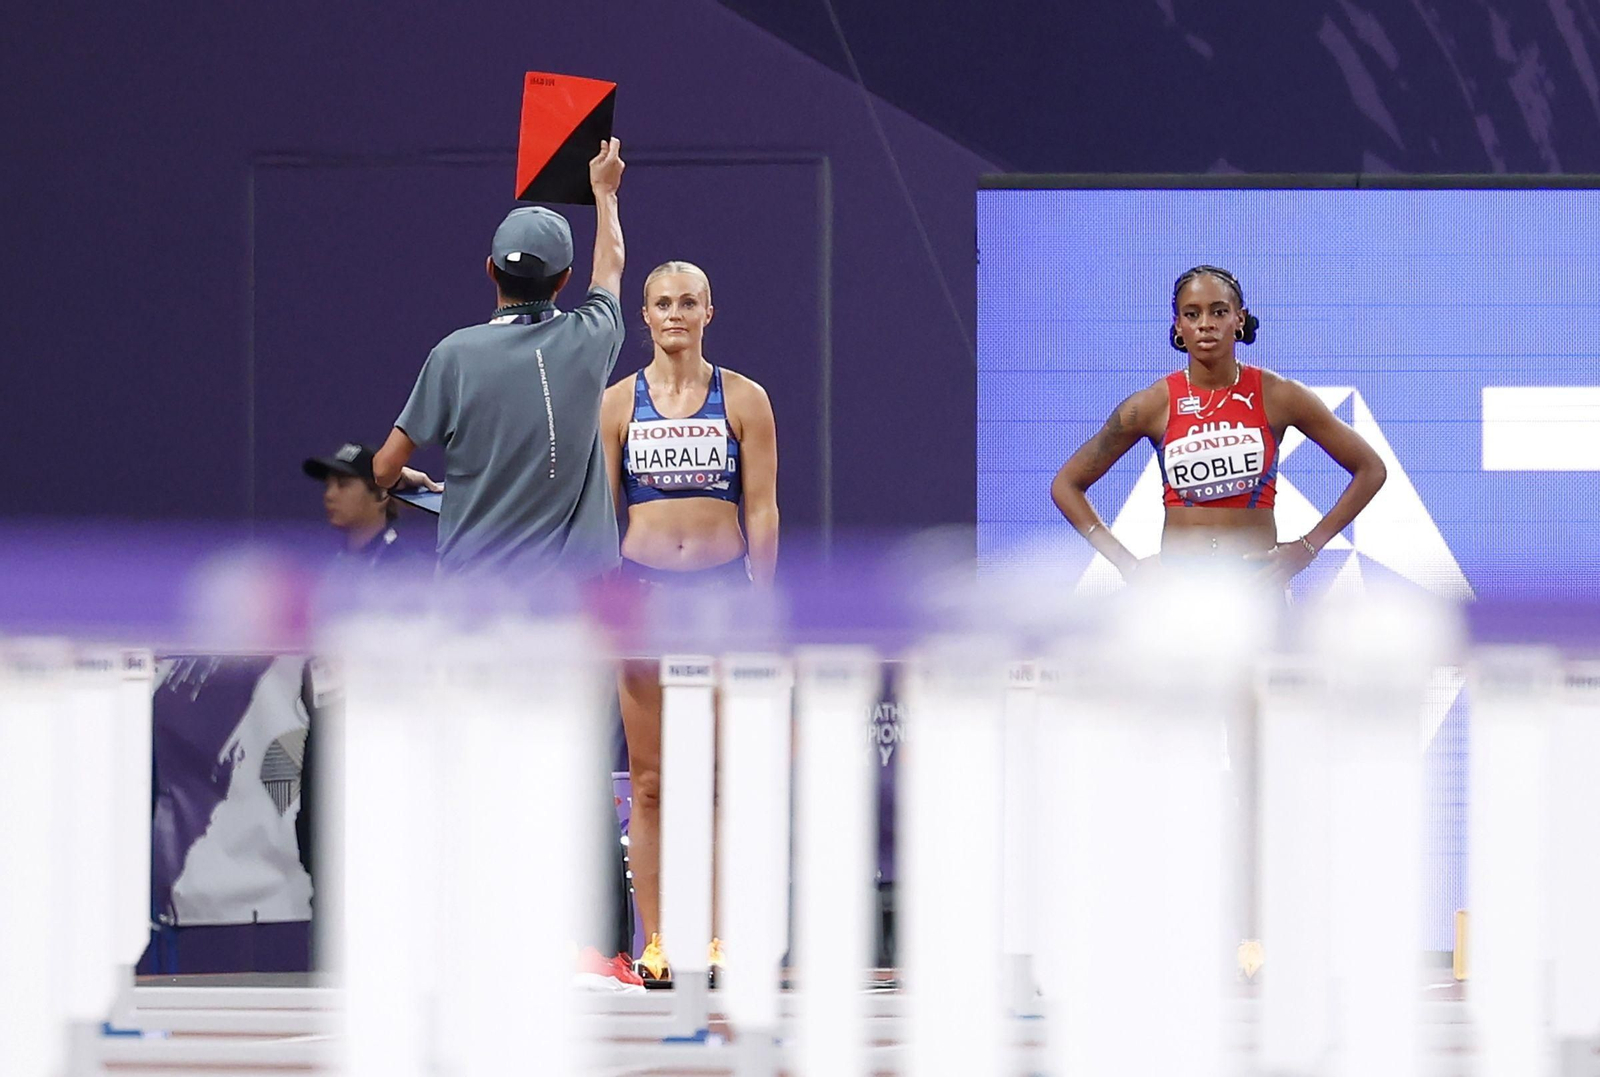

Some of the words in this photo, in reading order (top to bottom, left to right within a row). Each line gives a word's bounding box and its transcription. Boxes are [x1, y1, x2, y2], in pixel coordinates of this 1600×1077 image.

[631, 426, 723, 440] HONDA
[635, 447, 721, 470] HARALA
[1168, 434, 1259, 459] HONDA
[1173, 452, 1258, 485] ROBLE
